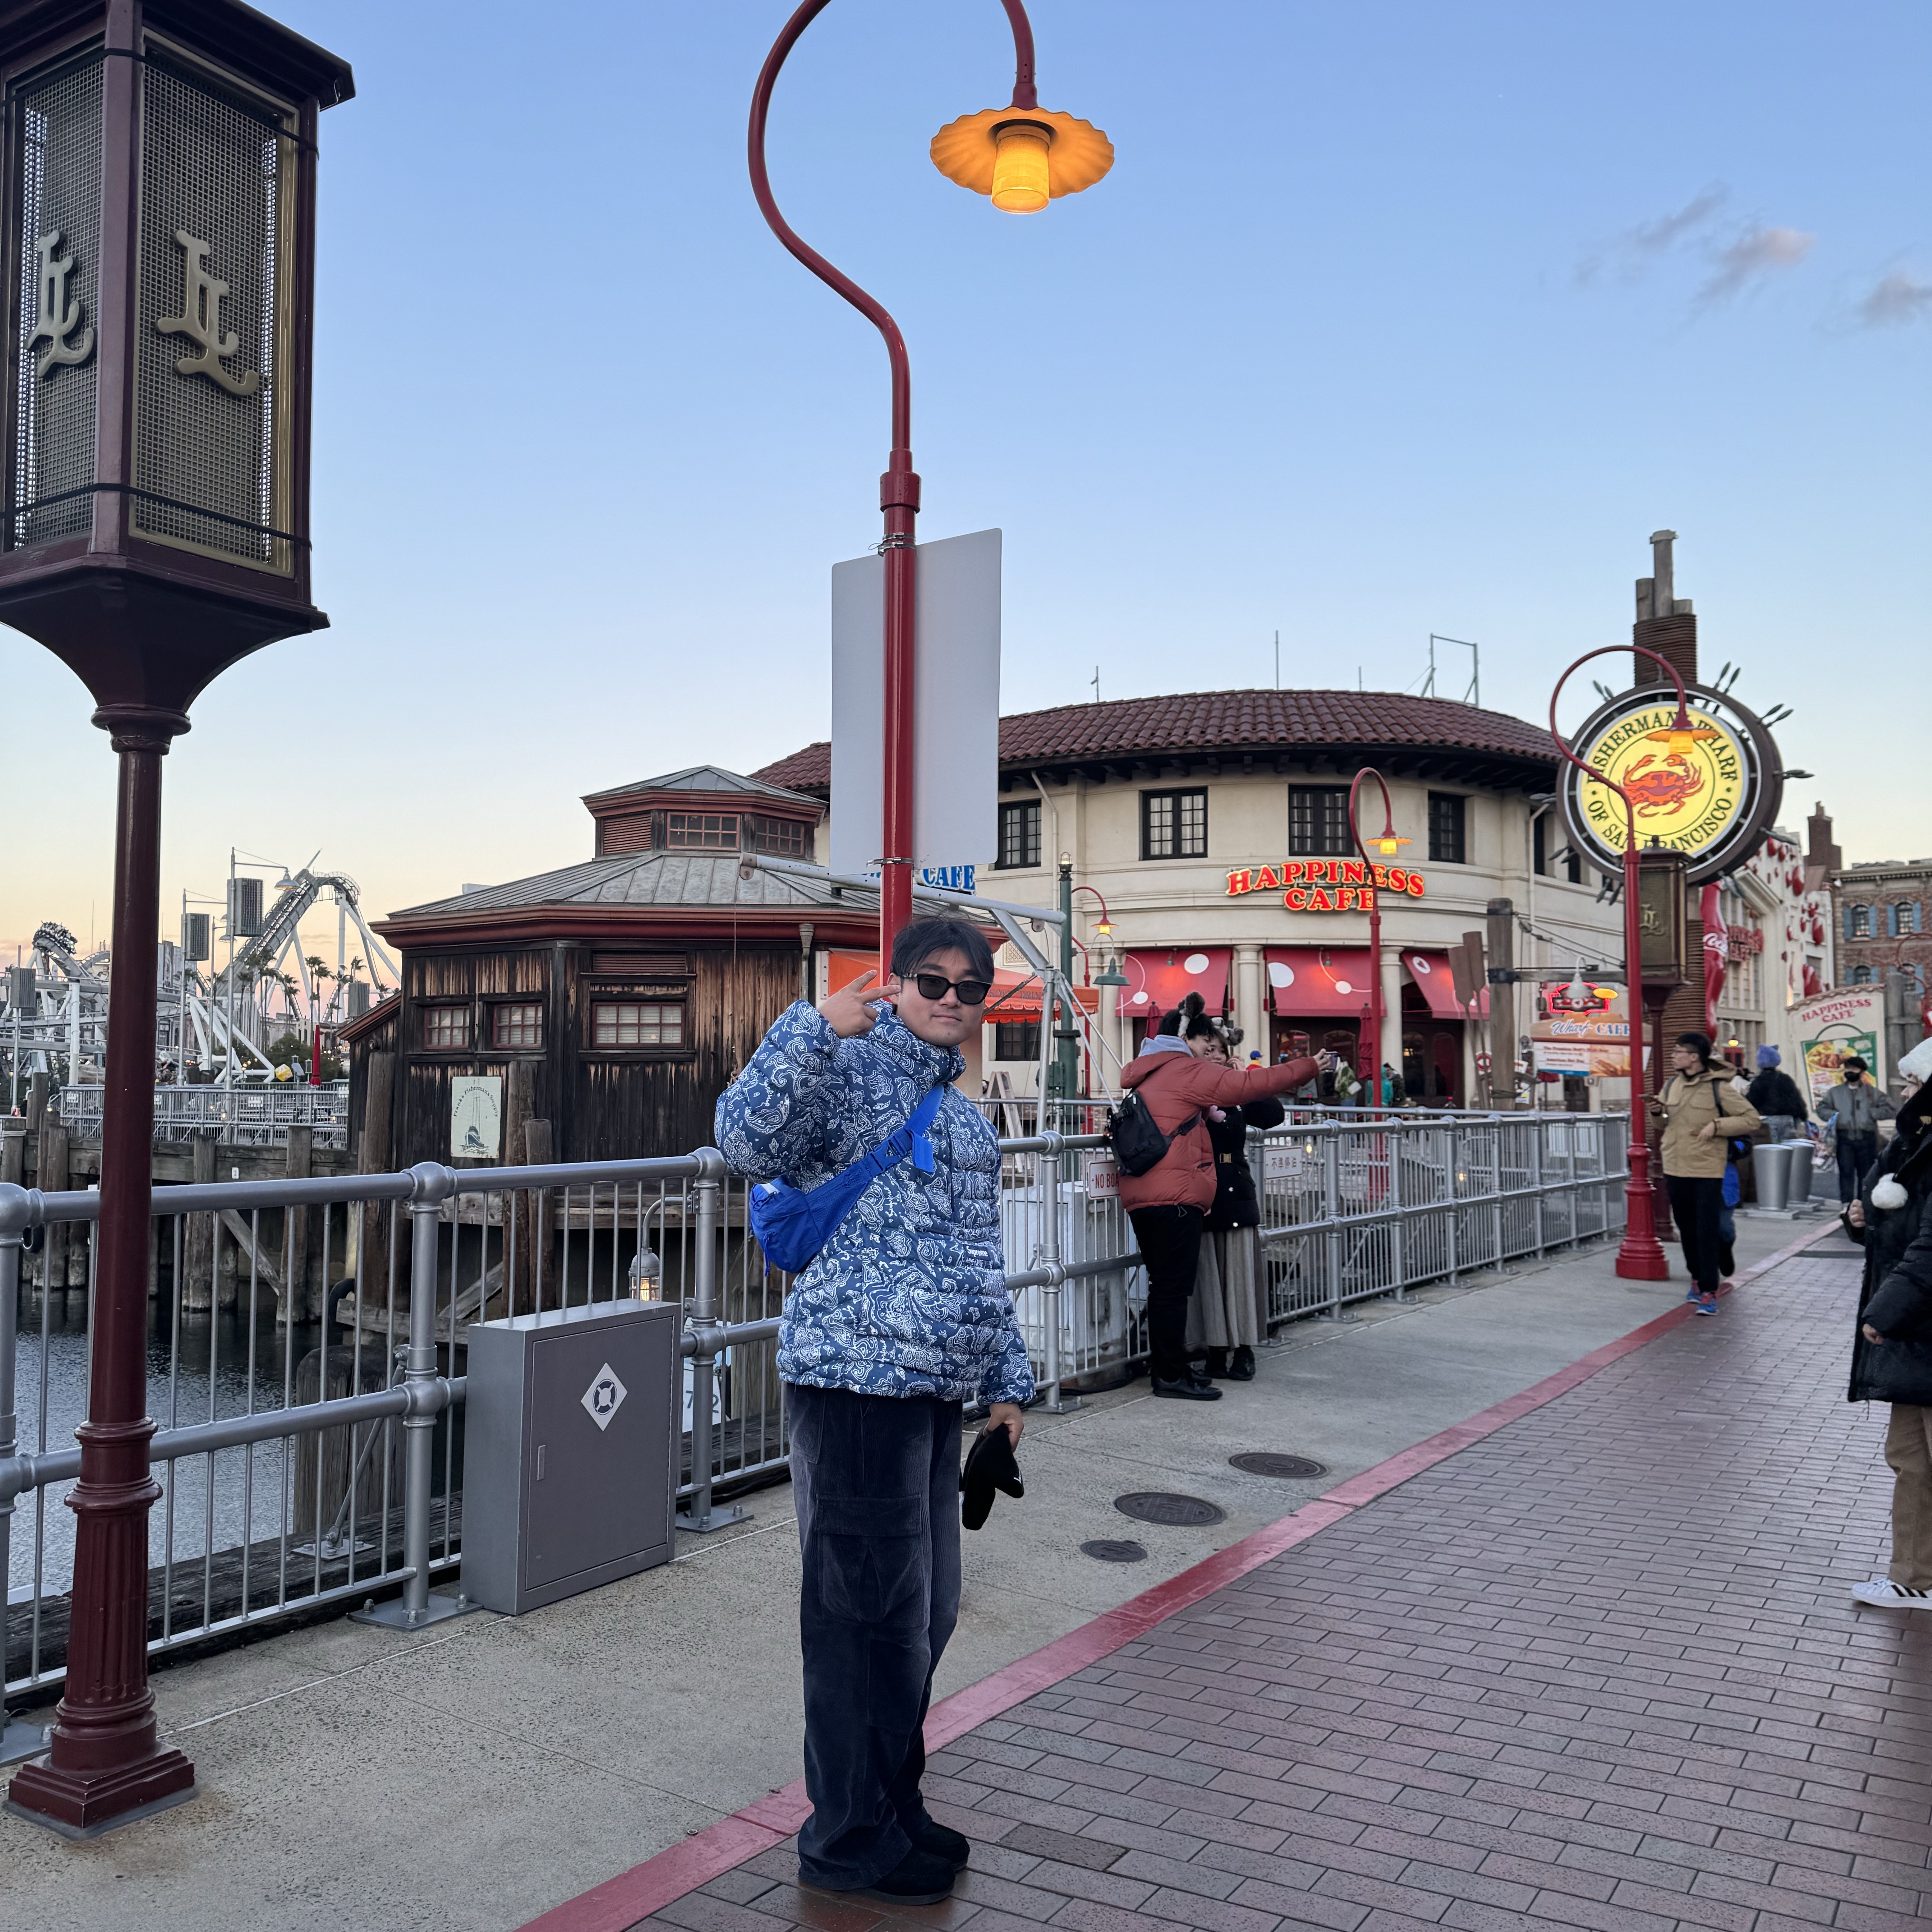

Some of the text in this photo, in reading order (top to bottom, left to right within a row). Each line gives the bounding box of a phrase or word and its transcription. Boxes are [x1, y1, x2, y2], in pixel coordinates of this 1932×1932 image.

[1588, 800, 1609, 821] OF
[1225, 860, 1425, 897] HAPPINESS
[1283, 887, 1374, 911] CAFE
[1802, 998, 1872, 1022] HAPPINESS
[1822, 1009, 1855, 1023] CAFE
[1551, 1019, 1593, 1038] Wharf
[489, 1095, 498, 1118] Supply
[1095, 1173, 1104, 1189] NO
[966, 1246, 988, 1257] Supreme
